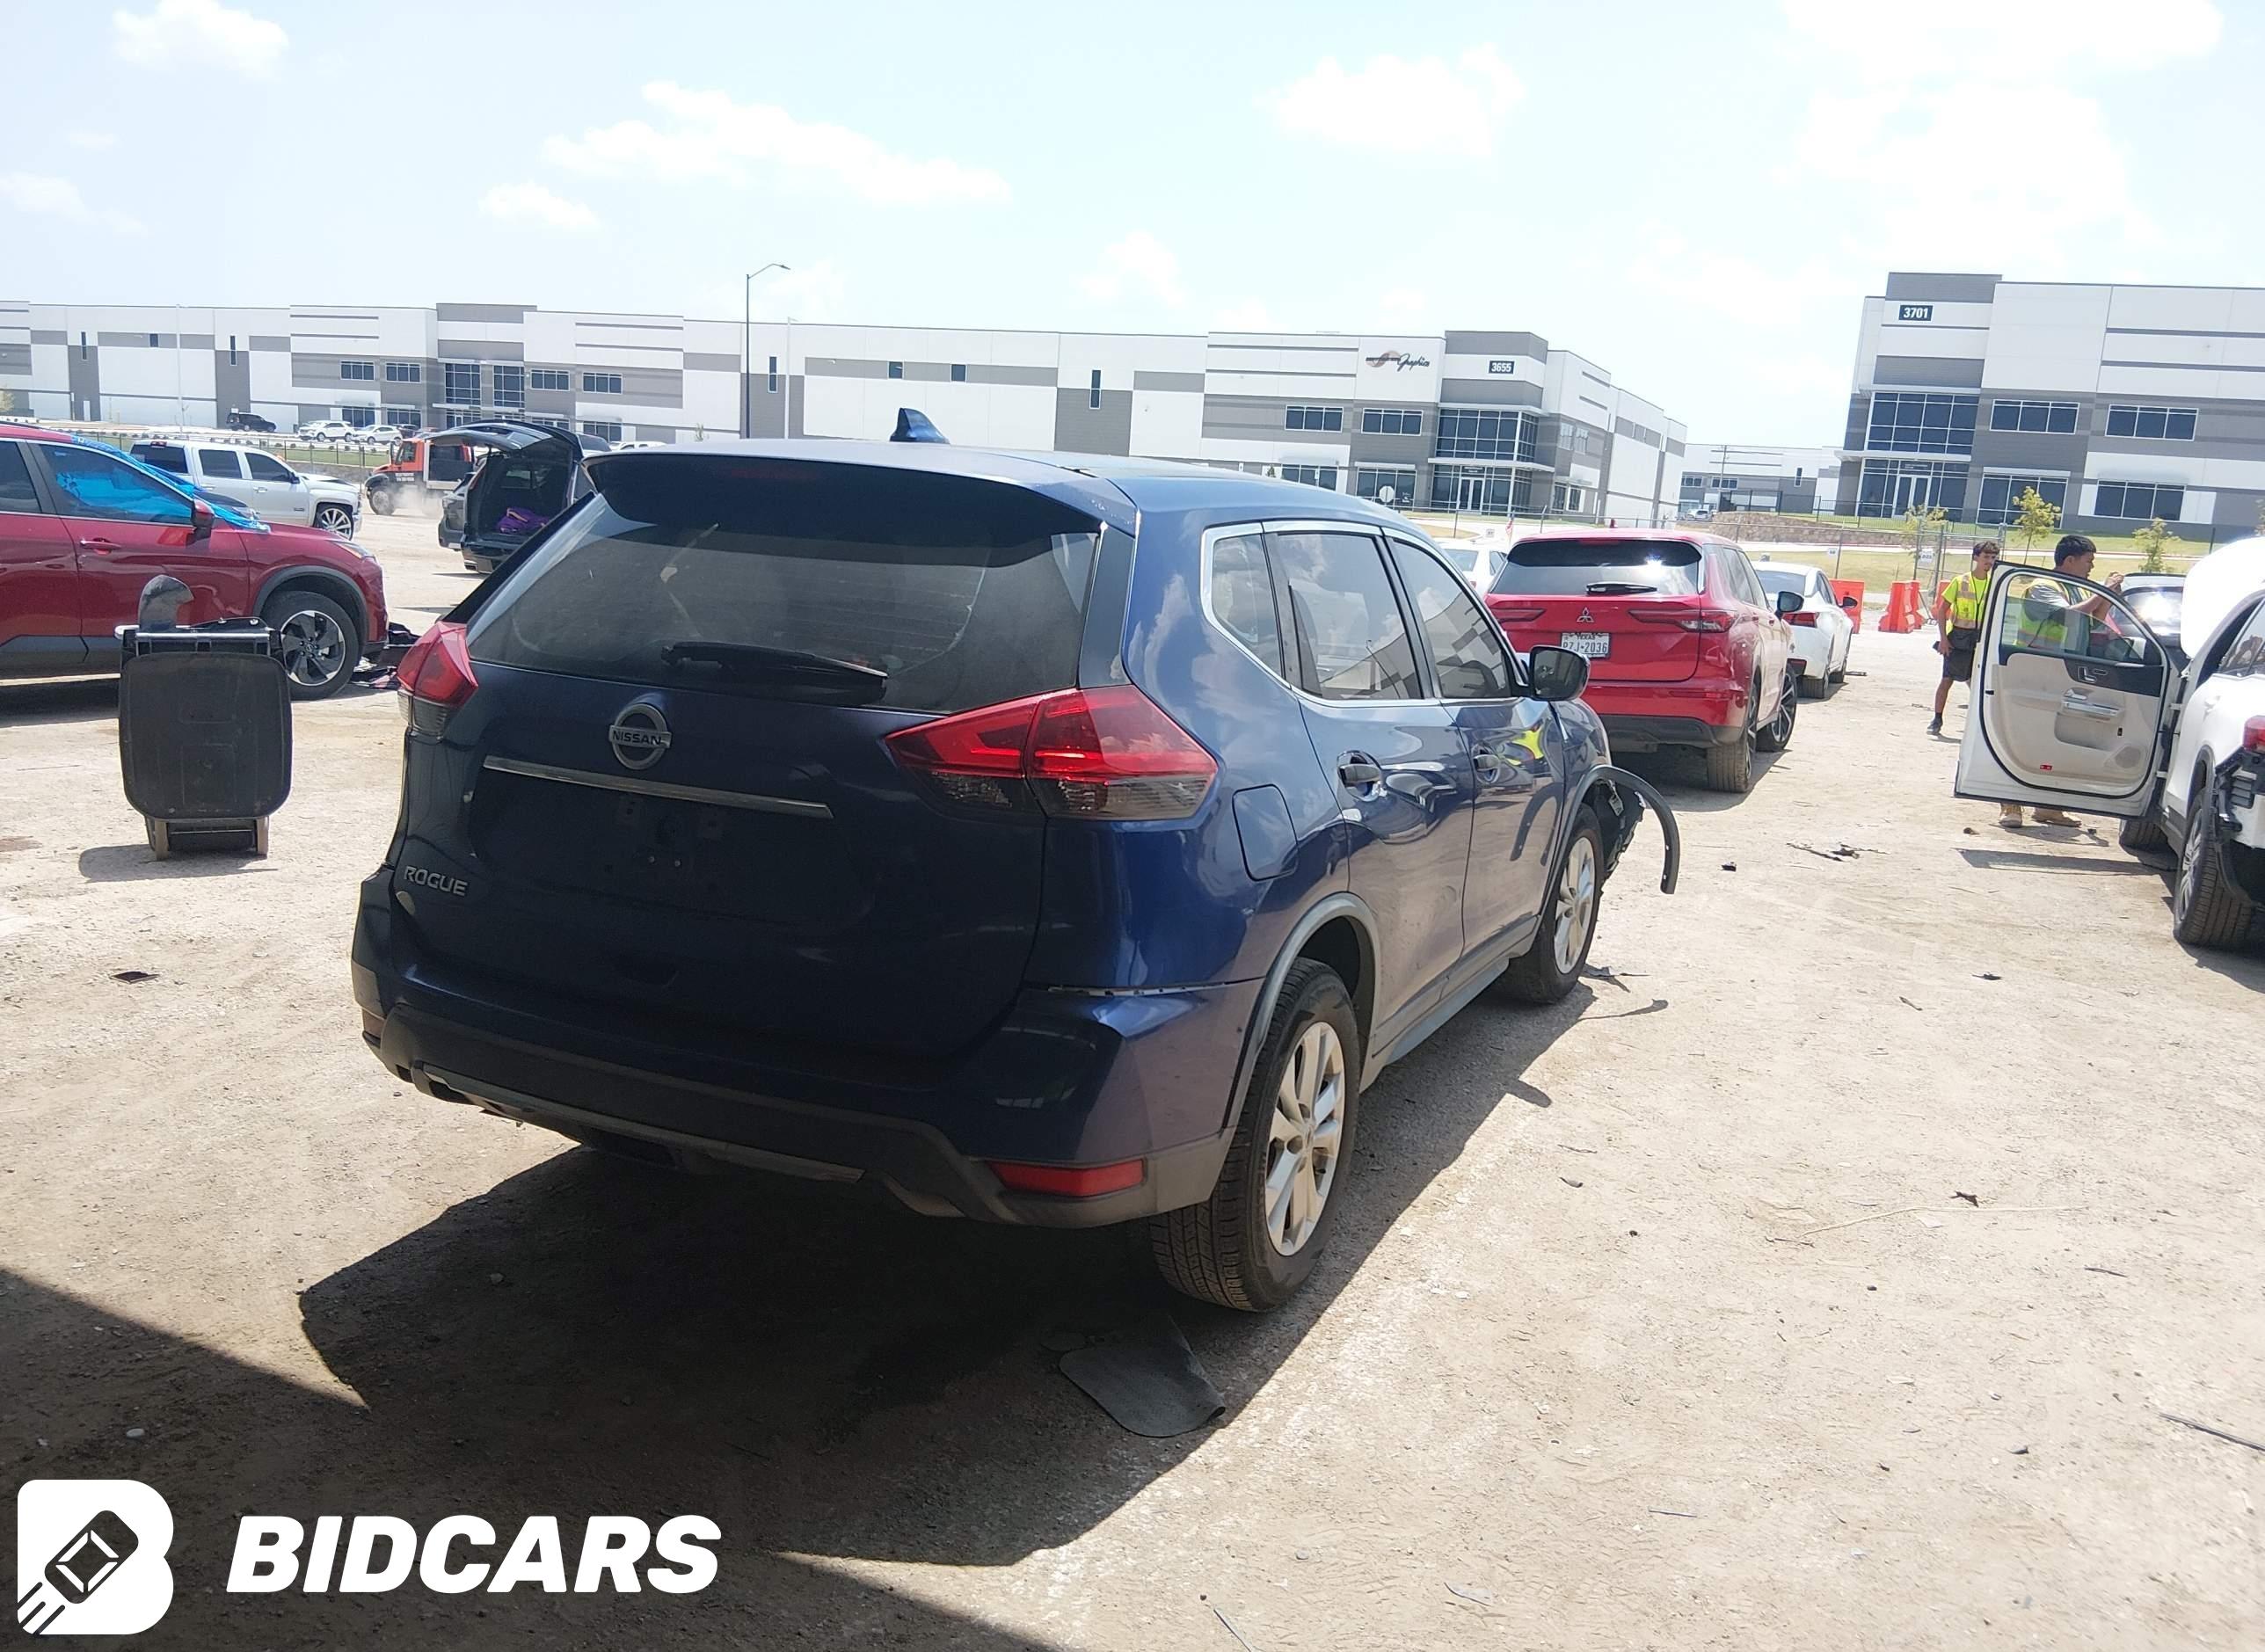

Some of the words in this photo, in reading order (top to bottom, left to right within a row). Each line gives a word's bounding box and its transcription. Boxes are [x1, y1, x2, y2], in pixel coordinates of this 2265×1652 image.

[1903, 307, 1928, 318] 3701
[1491, 362, 1512, 373] 3655
[613, 730, 662, 745] NISSAN
[404, 865, 469, 897] ROGUE
